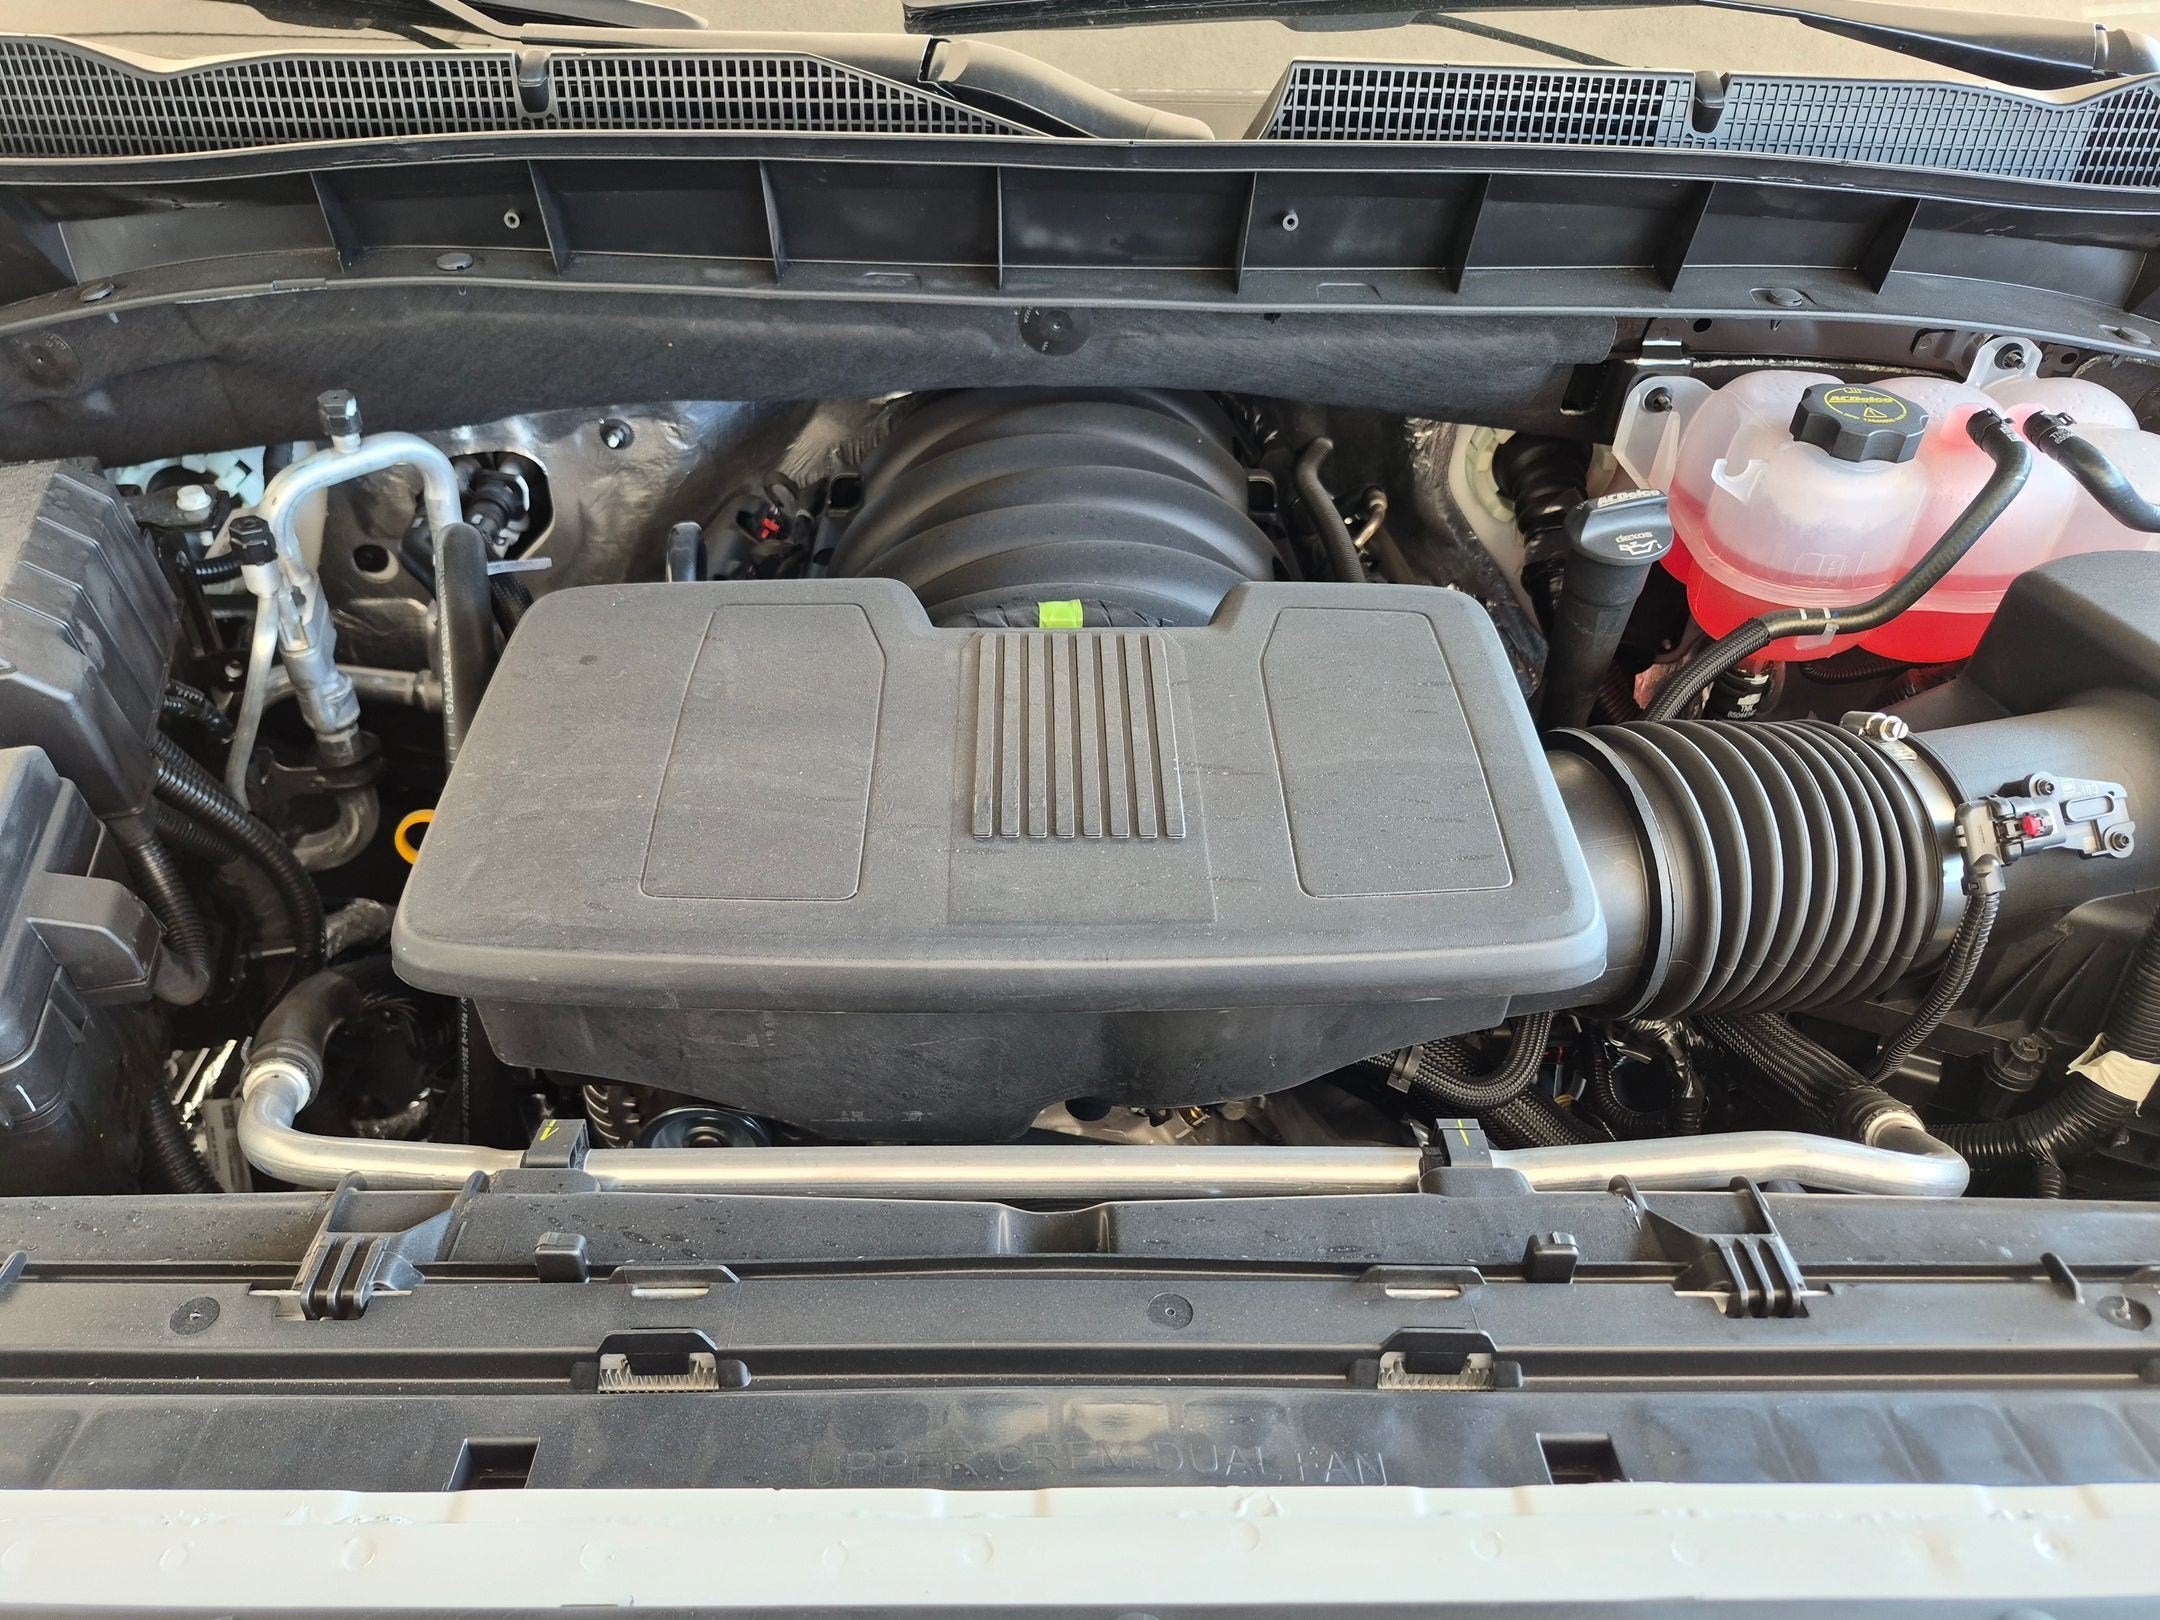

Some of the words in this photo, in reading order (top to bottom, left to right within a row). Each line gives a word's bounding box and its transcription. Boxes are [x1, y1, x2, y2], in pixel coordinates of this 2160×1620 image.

[1828, 395, 1895, 404] ACDelco
[1597, 490, 1660, 508] ACDelco
[1615, 531, 1653, 543] dexos
[443, 655, 454, 714] GALAXY
[461, 1046, 469, 1073] HOSE
[810, 1448, 978, 1486] UPPER
[1151, 1442, 1282, 1481] DUAL
